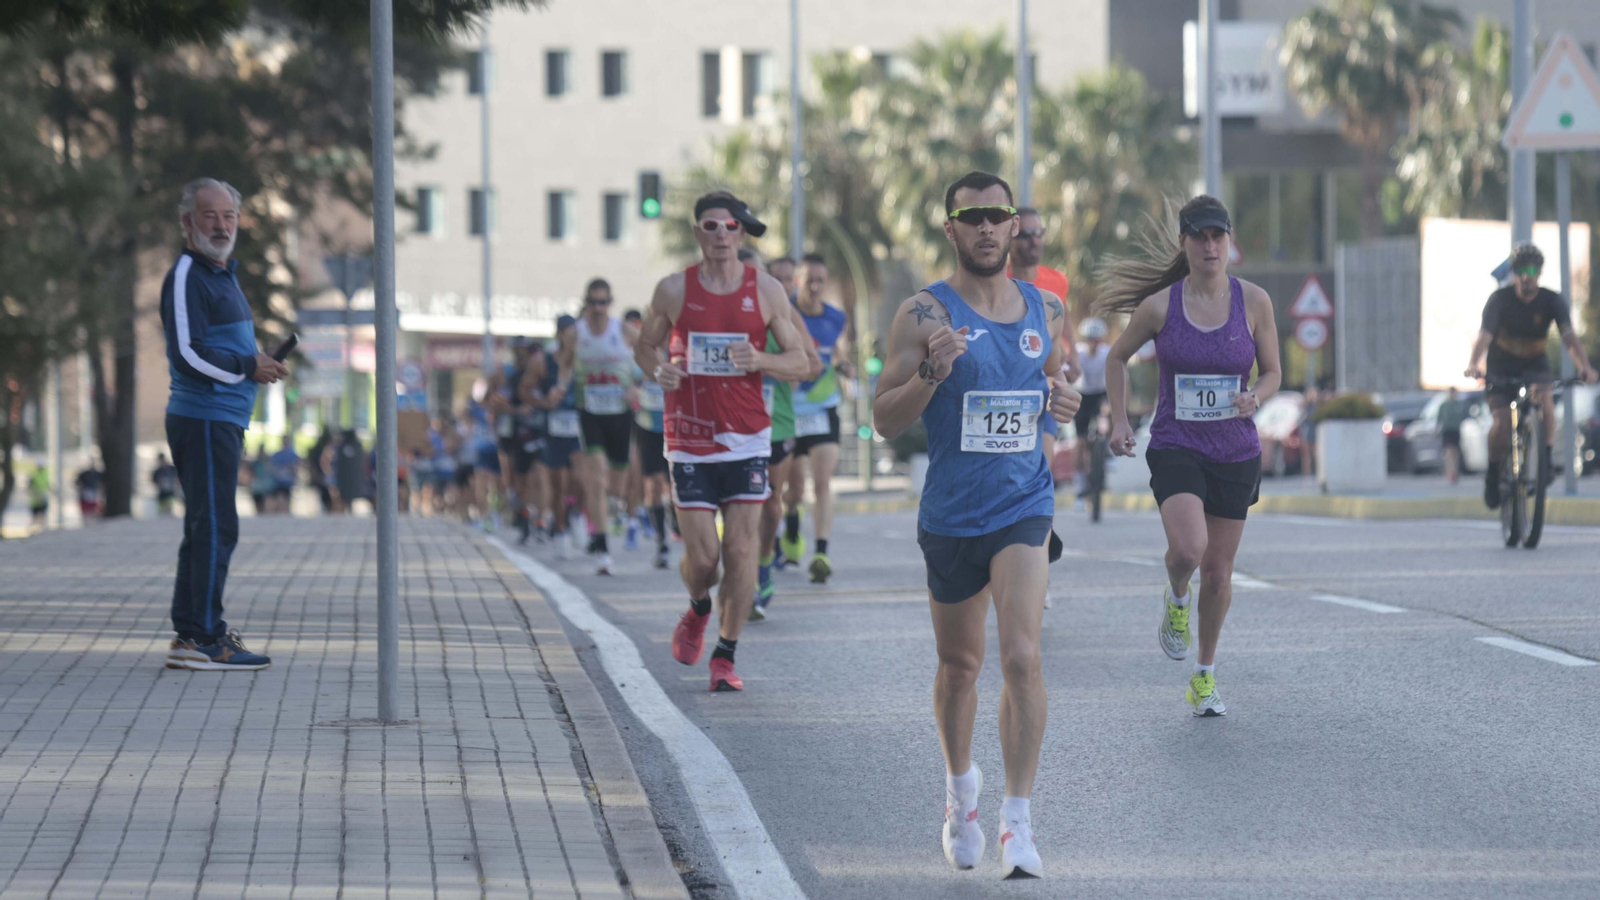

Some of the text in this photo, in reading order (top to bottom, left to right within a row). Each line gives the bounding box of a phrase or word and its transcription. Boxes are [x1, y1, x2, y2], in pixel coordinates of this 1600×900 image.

[702, 347, 729, 363] 134
[990, 398, 1021, 407] MARATÓN
[1196, 390, 1216, 407] 10
[983, 411, 1021, 434] 125
[983, 440, 1019, 449] EVOS
